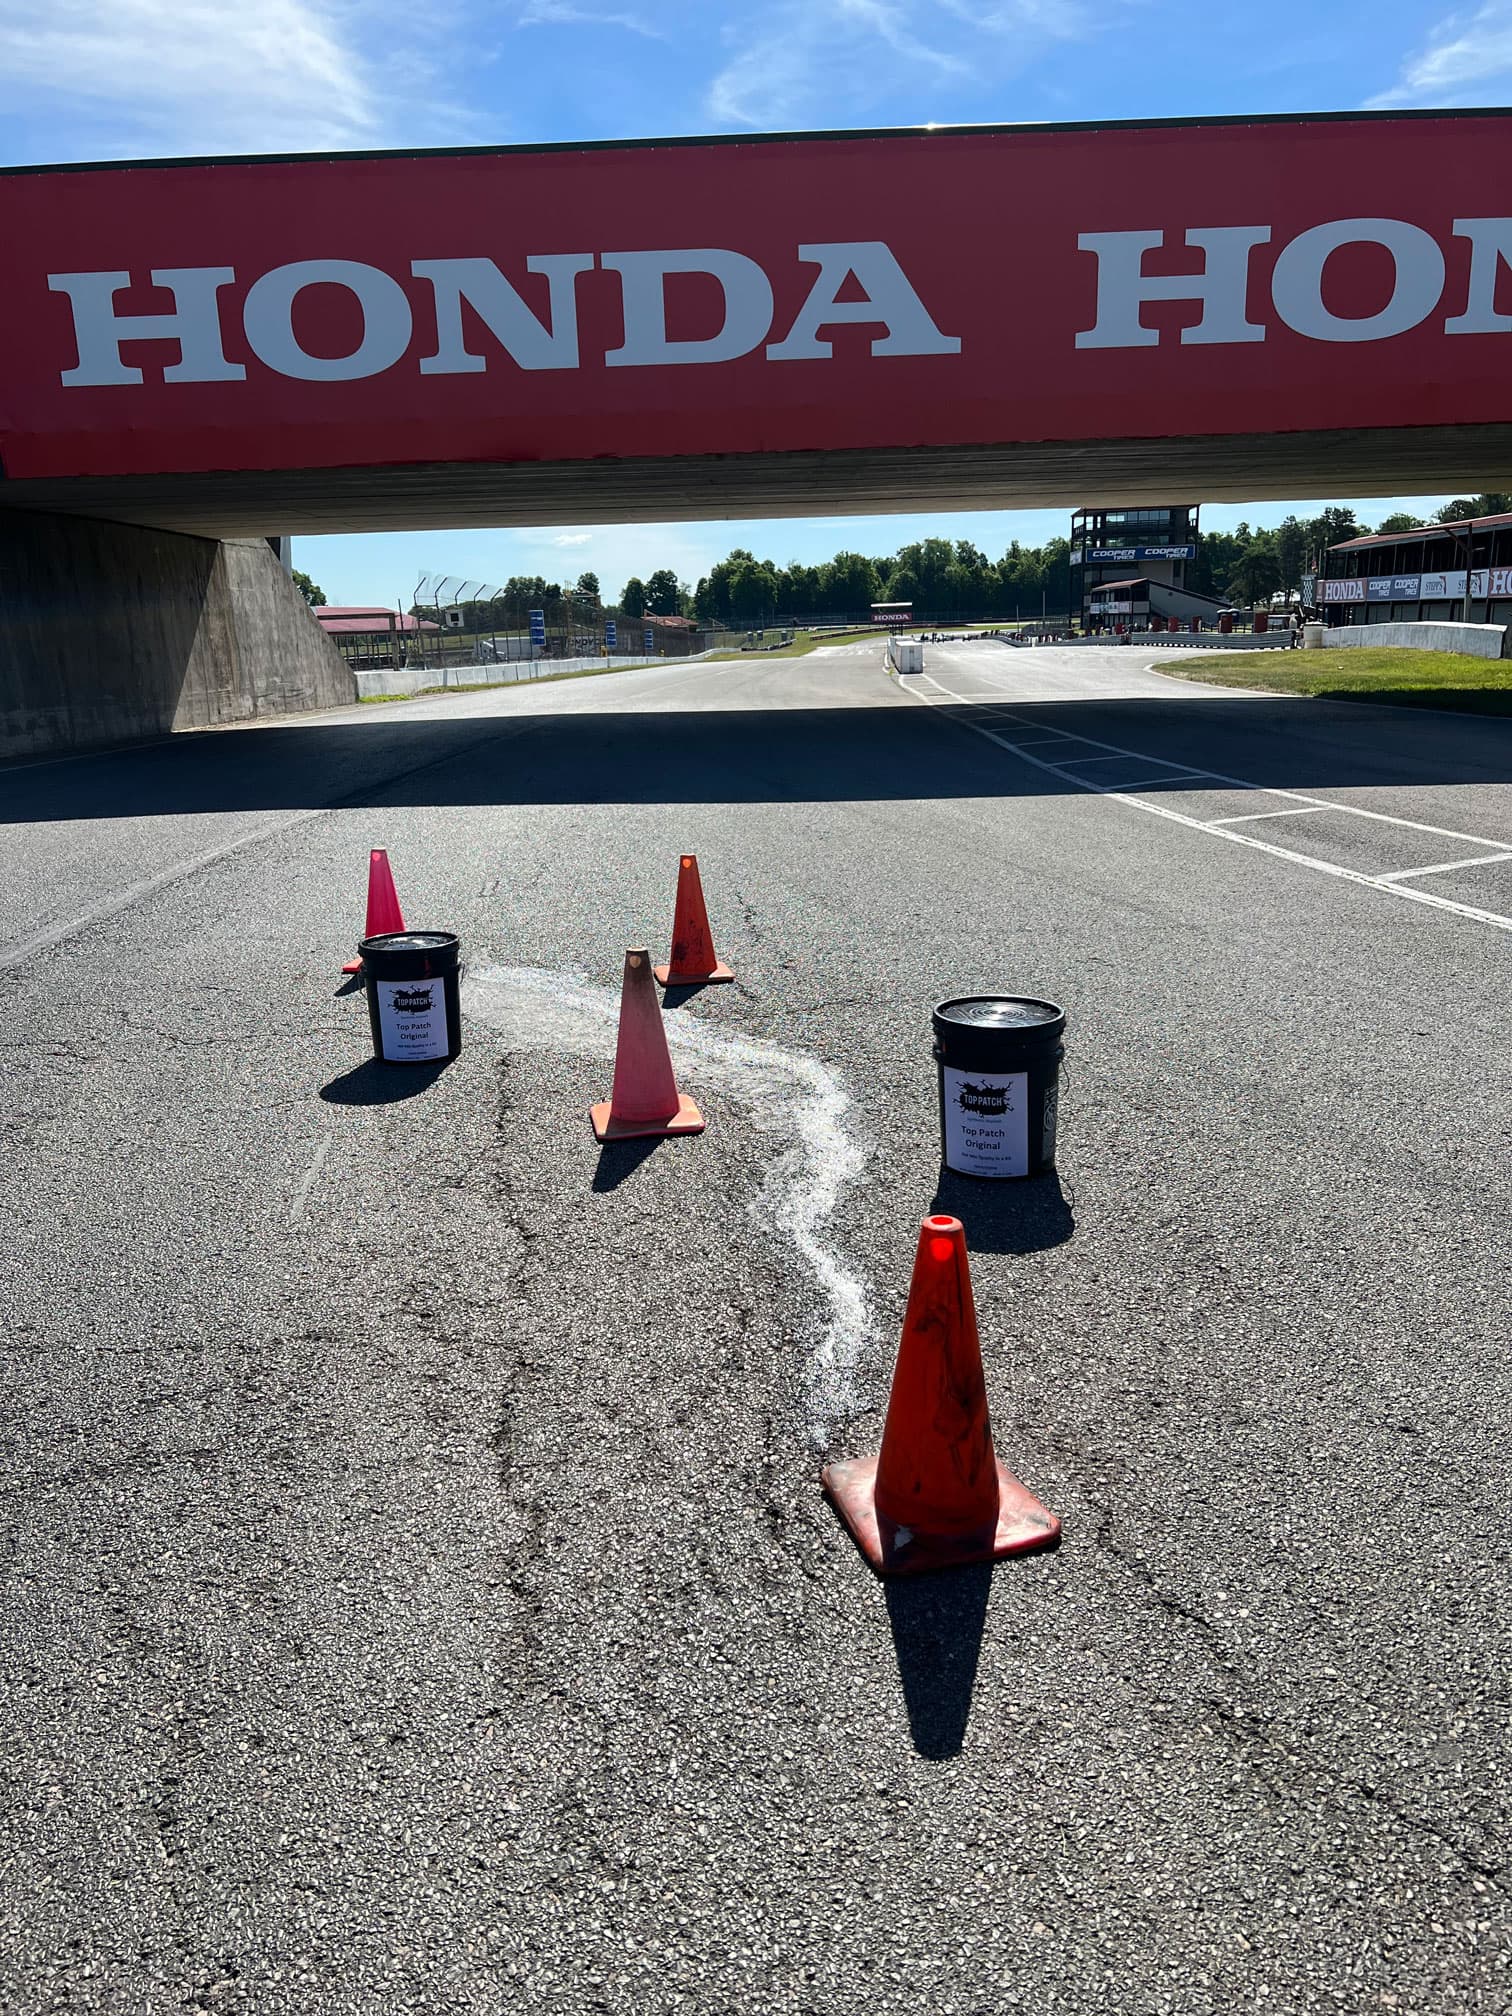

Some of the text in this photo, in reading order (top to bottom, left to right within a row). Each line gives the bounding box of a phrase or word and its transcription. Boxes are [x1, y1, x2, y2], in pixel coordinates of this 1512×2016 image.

[47, 241, 962, 387] HONDA
[1092, 549, 1136, 557] COOPER
[1145, 547, 1188, 555] COOPER
[1369, 581, 1391, 590] COOPER
[1394, 579, 1419, 589] COOPER
[1325, 581, 1364, 600] HONDA
[396, 1023, 409, 1031] Top
[400, 1032, 429, 1040] Original
[961, 1125, 1005, 1138] Top Patch
[966, 1139, 1001, 1150] Original
